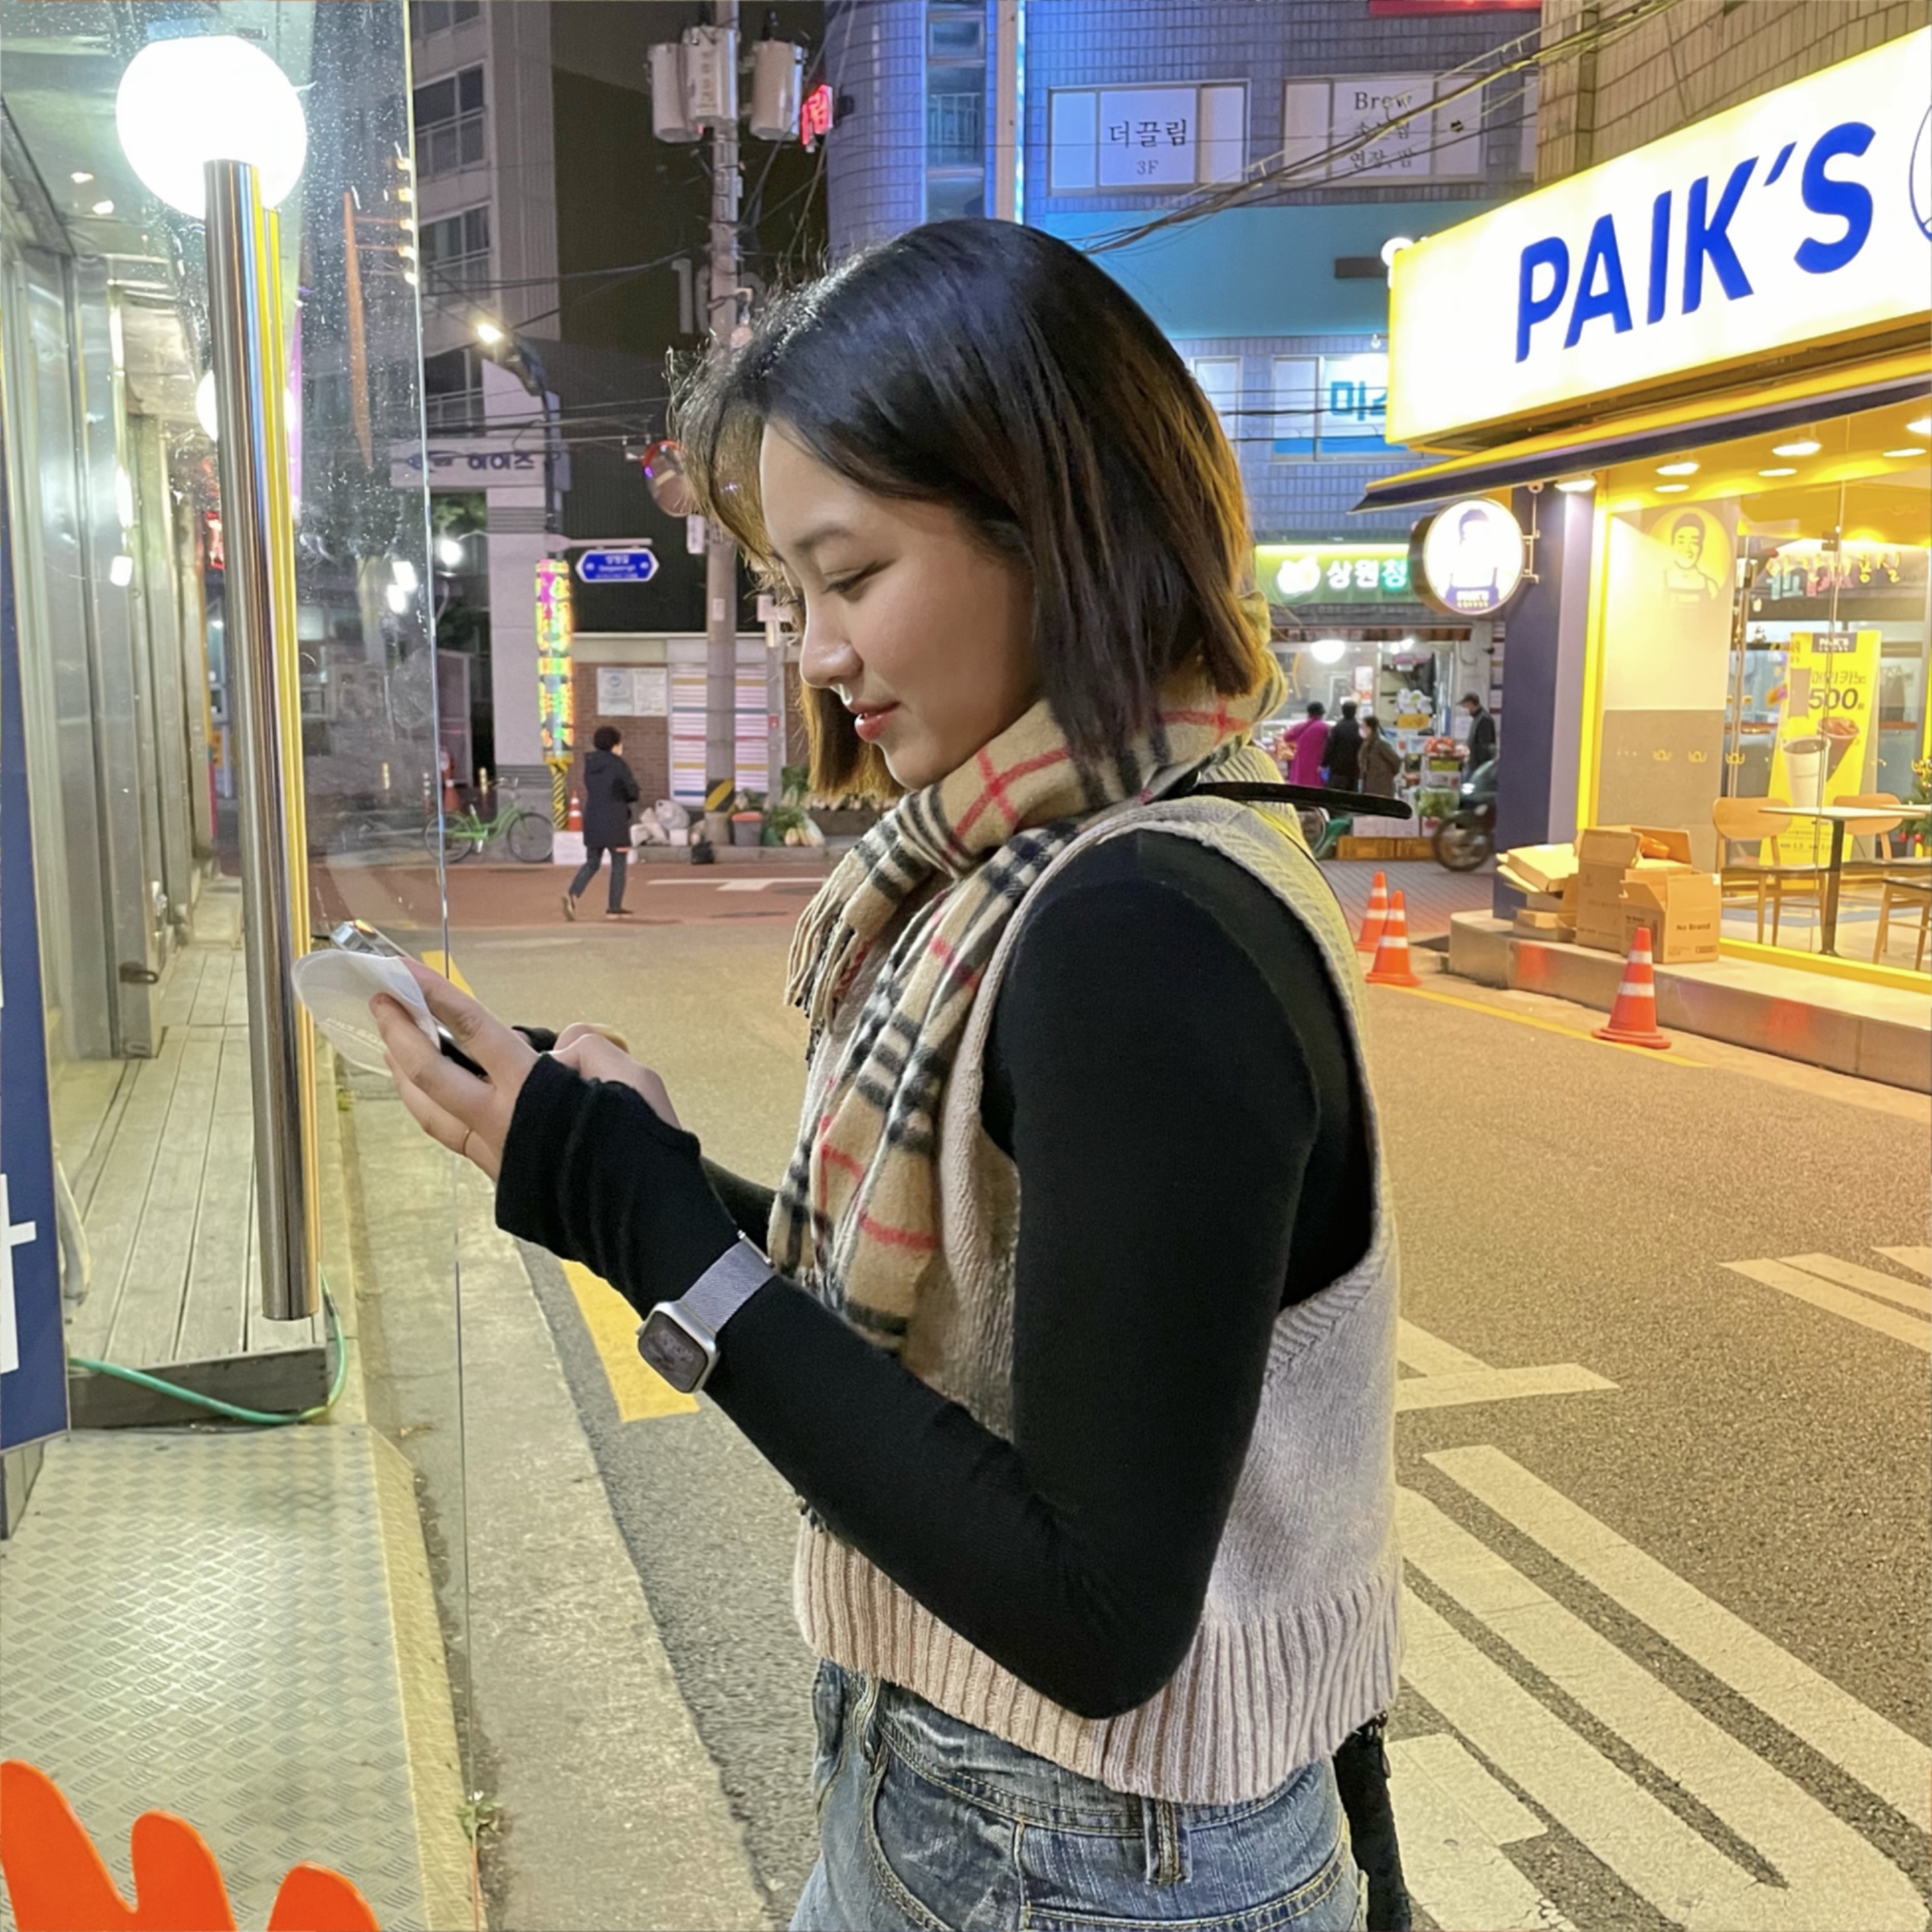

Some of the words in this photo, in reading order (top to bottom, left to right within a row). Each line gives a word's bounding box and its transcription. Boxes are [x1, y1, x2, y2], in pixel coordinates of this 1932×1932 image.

[1109, 118, 1186, 148] 더끌림
[1137, 160, 1159, 174] 3F
[1515, 121, 1876, 364] PAIK'S
[1808, 687, 1859, 710] 500
